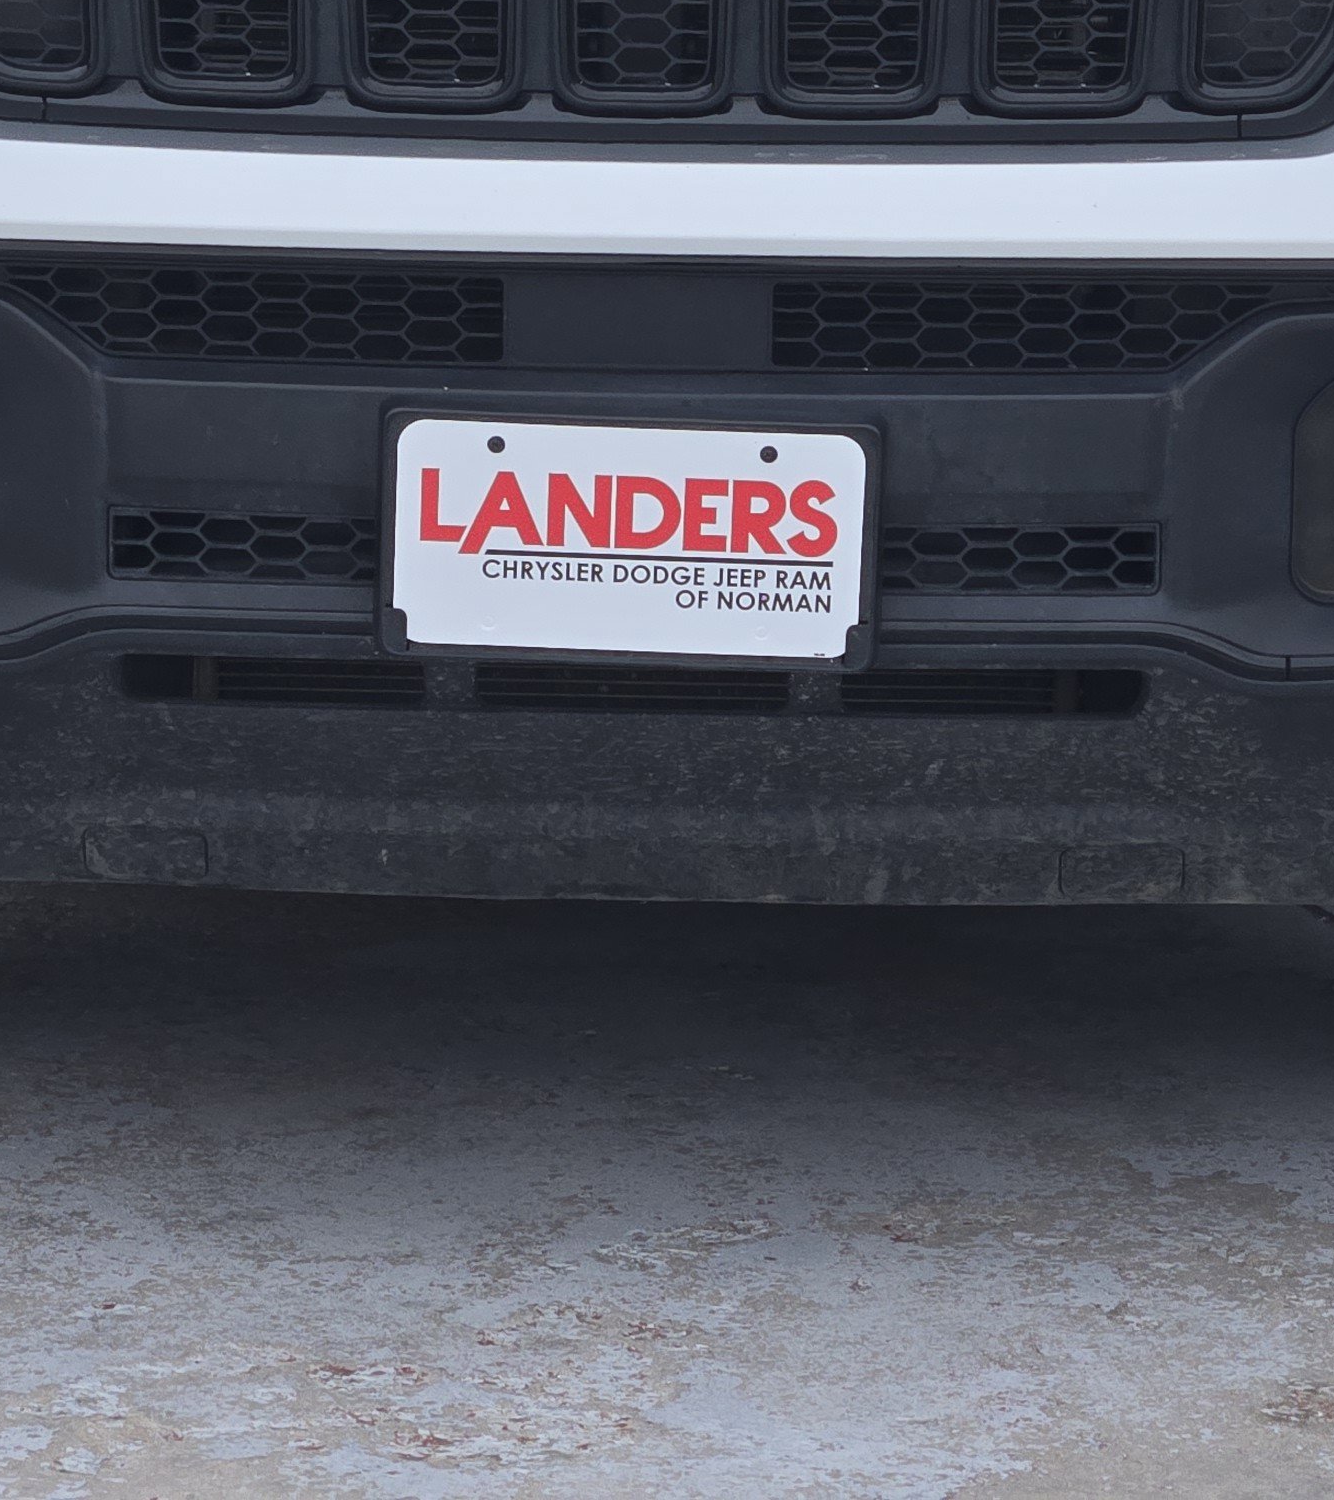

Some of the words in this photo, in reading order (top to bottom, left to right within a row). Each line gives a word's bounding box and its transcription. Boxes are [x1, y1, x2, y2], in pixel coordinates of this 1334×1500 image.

[419, 467, 838, 557] LANDERS
[482, 558, 604, 583] CHRYSLER
[612, 564, 705, 586] DODGE
[712, 567, 767, 589] JEEP
[775, 569, 832, 591] RAM
[675, 589, 709, 609] OF
[717, 590, 832, 614] NORMAN
